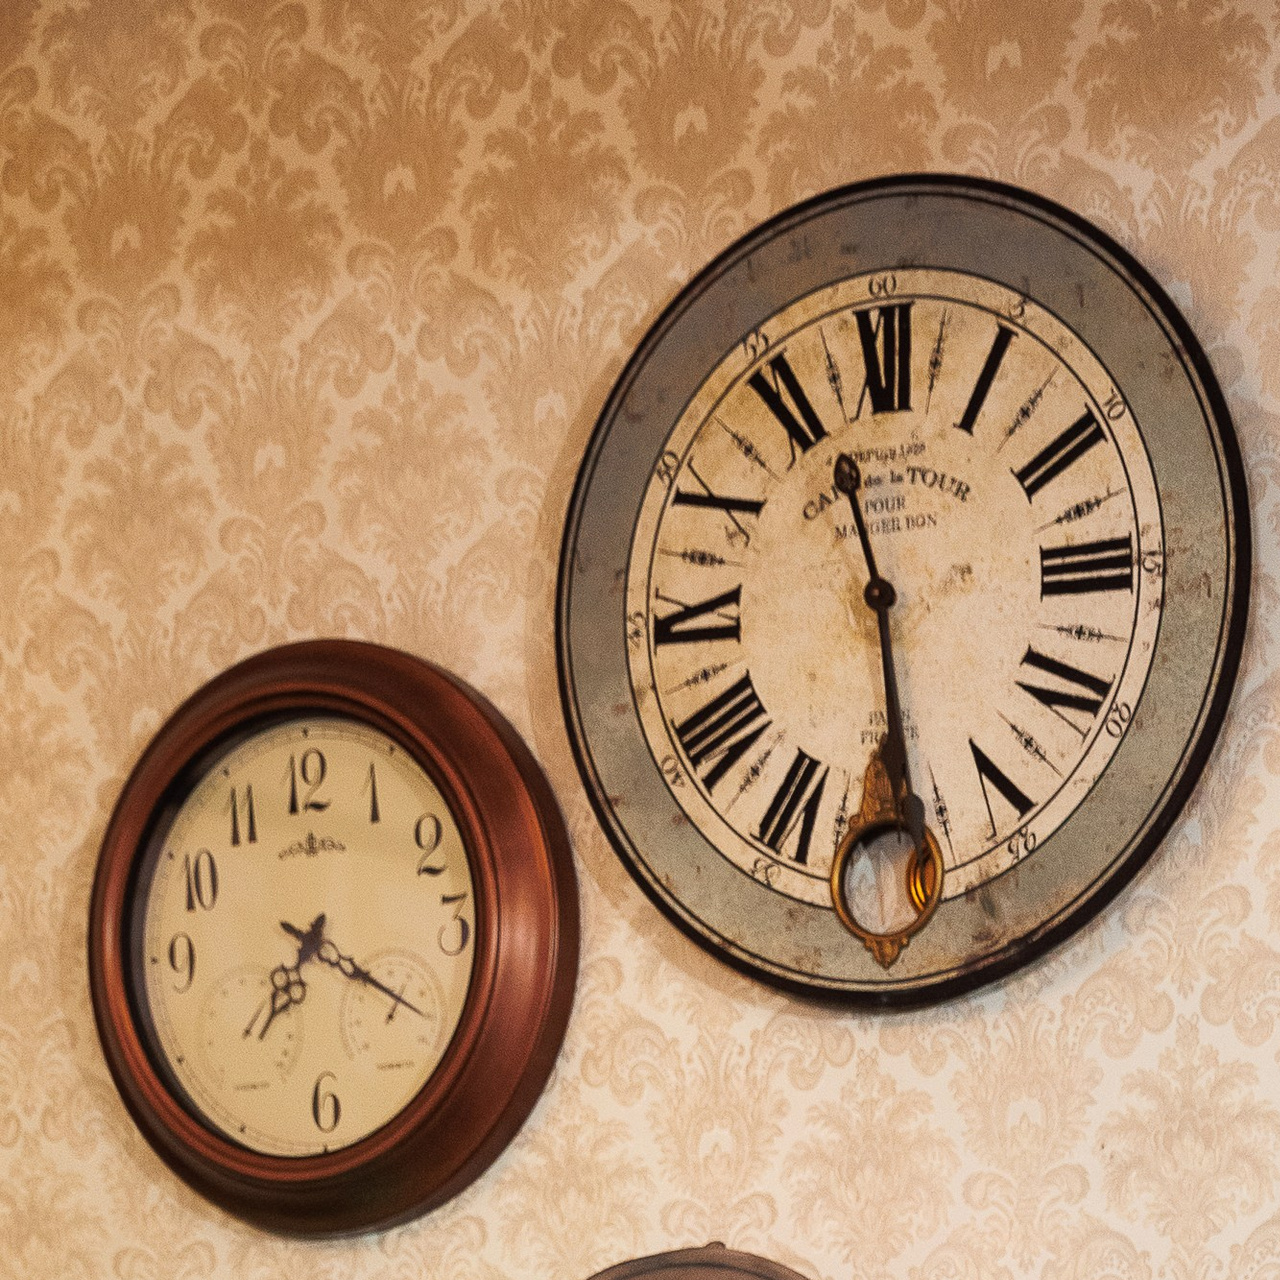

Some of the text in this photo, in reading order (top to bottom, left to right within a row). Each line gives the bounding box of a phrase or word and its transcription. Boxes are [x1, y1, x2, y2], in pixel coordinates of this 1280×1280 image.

[868, 274, 897, 297] 60
[850, 301, 914, 422] XII
[953, 316, 1018, 436] I
[746, 347, 831, 472] XI
[1101, 387, 1126, 421] 10
[906, 466, 971, 503] TOUR
[1010, 402, 1108, 504] II
[671, 455, 767, 547] X
[835, 513, 938, 538] MAGER BON
[865, 498, 905, 515] POUR
[1039, 531, 1133, 602] III
[1141, 540, 1163, 579] 15
[628, 610, 648, 649] 45
[654, 584, 743, 656] IX
[1014, 644, 1115, 748] IV
[1105, 700, 1132, 739] 20
[671, 669, 773, 797] VIII
[284, 748, 331, 816] 12
[361, 761, 380, 824] 1
[750, 746, 830, 866] VII
[969, 736, 1039, 842] V
[226, 784, 258, 847] 11
[414, 812, 446, 876] 2
[183, 848, 219, 913] 10
[438, 891, 470, 956] 3
[169, 931, 196, 993] 9
[312, 1071, 342, 1133] 6
